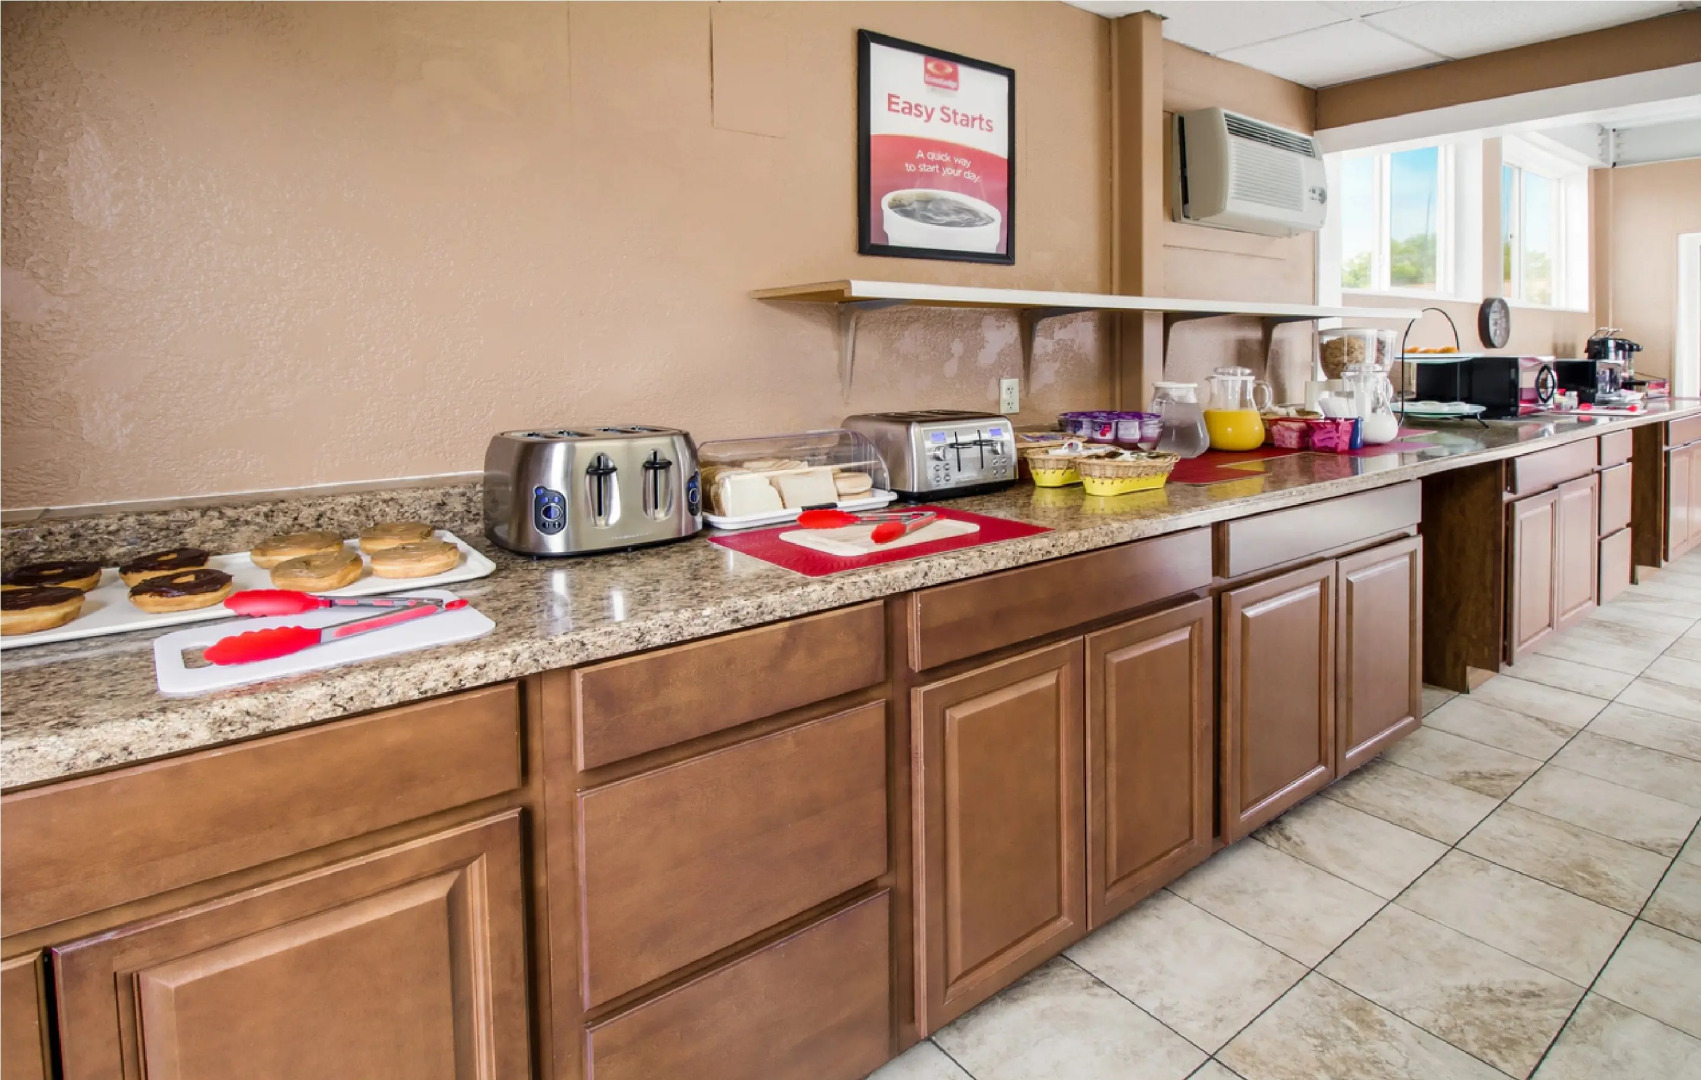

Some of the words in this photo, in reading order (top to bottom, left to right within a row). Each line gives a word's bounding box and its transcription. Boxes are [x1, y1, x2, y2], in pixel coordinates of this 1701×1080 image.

[887, 93, 935, 123] Easy
[940, 105, 994, 133] Starts
[916, 150, 925, 159] A
[926, 151, 951, 162] quick
[953, 156, 971, 168] way
[905, 163, 916, 172] to
[918, 163, 939, 173] start
[941, 166, 962, 176] your
